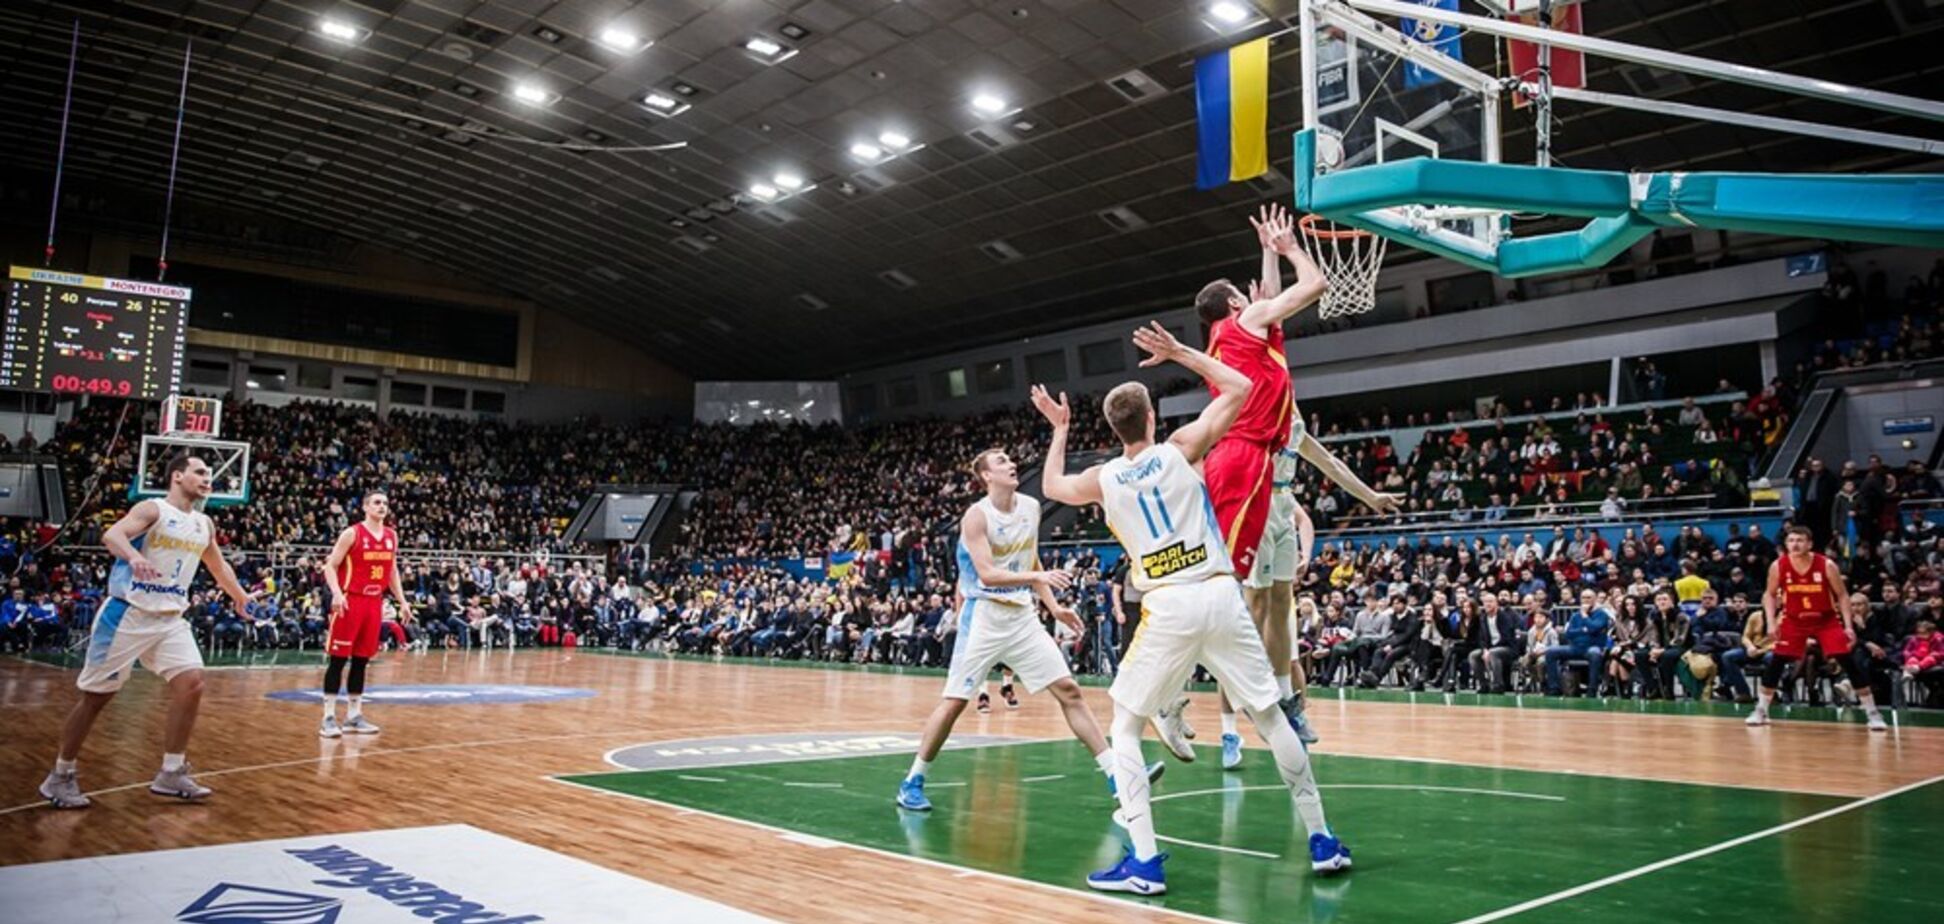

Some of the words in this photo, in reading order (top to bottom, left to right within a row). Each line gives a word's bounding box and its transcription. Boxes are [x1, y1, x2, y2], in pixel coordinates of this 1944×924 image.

[1318, 67, 1344, 87] FIBA
[1809, 255, 1820, 272] 7
[31, 271, 83, 284] UKRAINE
[110, 281, 186, 298] MONTENEGRO
[60, 292, 79, 304] 40
[125, 299, 143, 312] 26
[96, 320, 104, 330] 2
[52, 375, 131, 396] 00:49.9
[1137, 486, 1174, 539] 11
[1143, 545, 1182, 568] PARI
[1150, 547, 1206, 577] MATCH
[171, 559, 183, 579] 3
[371, 565, 384, 580] 30
[1802, 596, 1812, 609] 6
